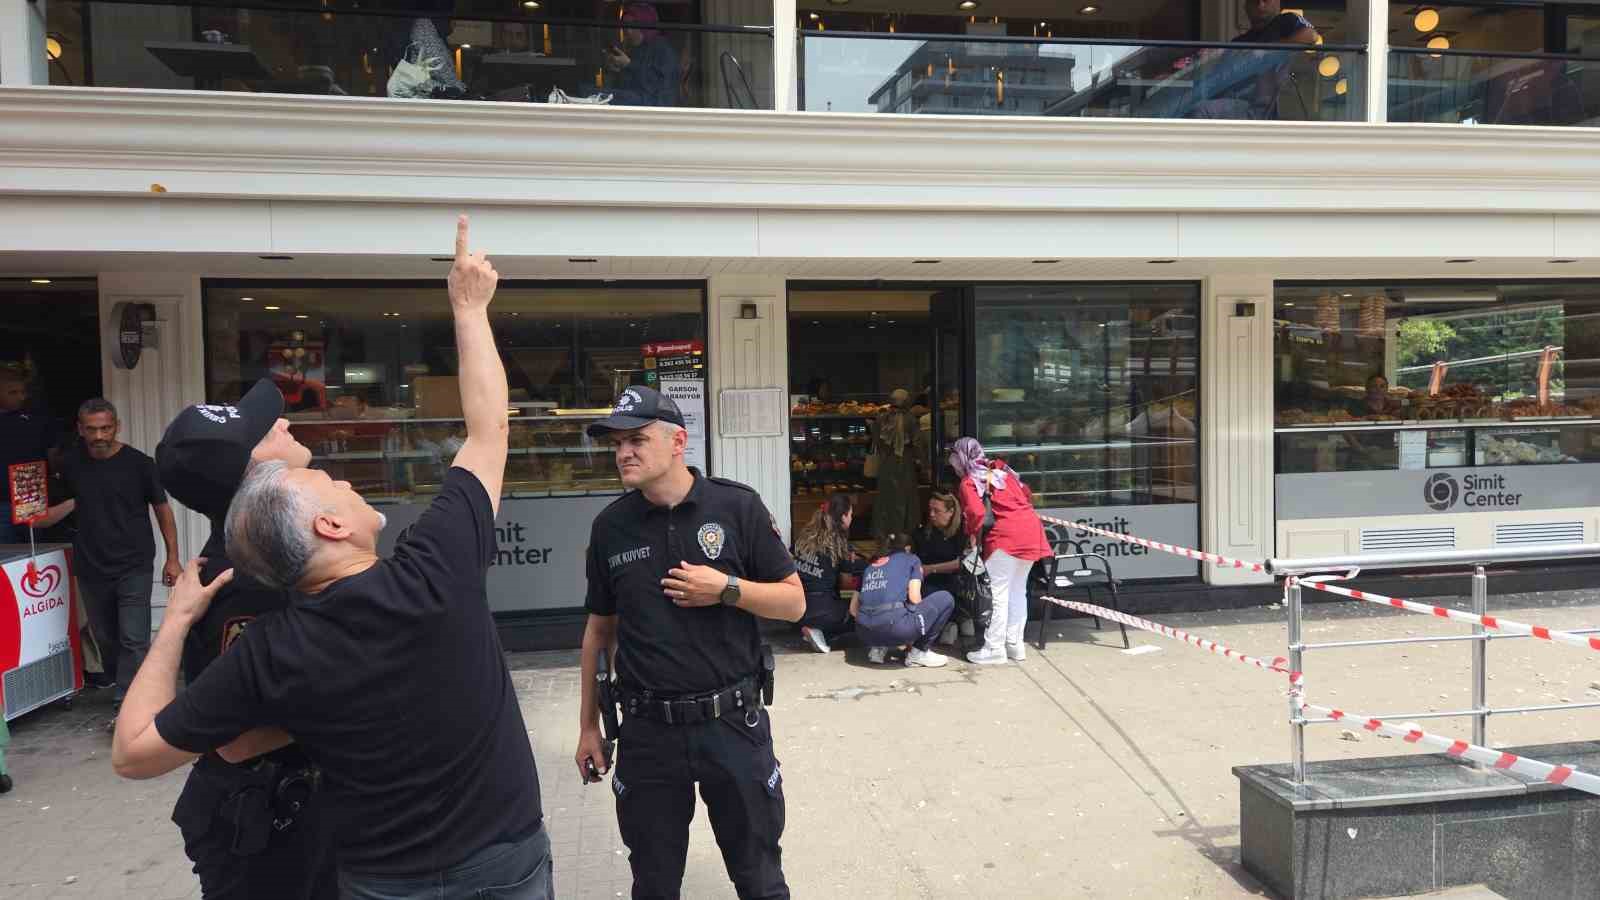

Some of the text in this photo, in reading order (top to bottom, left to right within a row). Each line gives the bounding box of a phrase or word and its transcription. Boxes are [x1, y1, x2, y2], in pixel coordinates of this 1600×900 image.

[1463, 473, 1505, 490] Simit
[1463, 491, 1522, 506] Center
[1075, 516, 1130, 538] Simit
[491, 545, 553, 566] nter
[23, 597, 65, 618] ALGIDA
